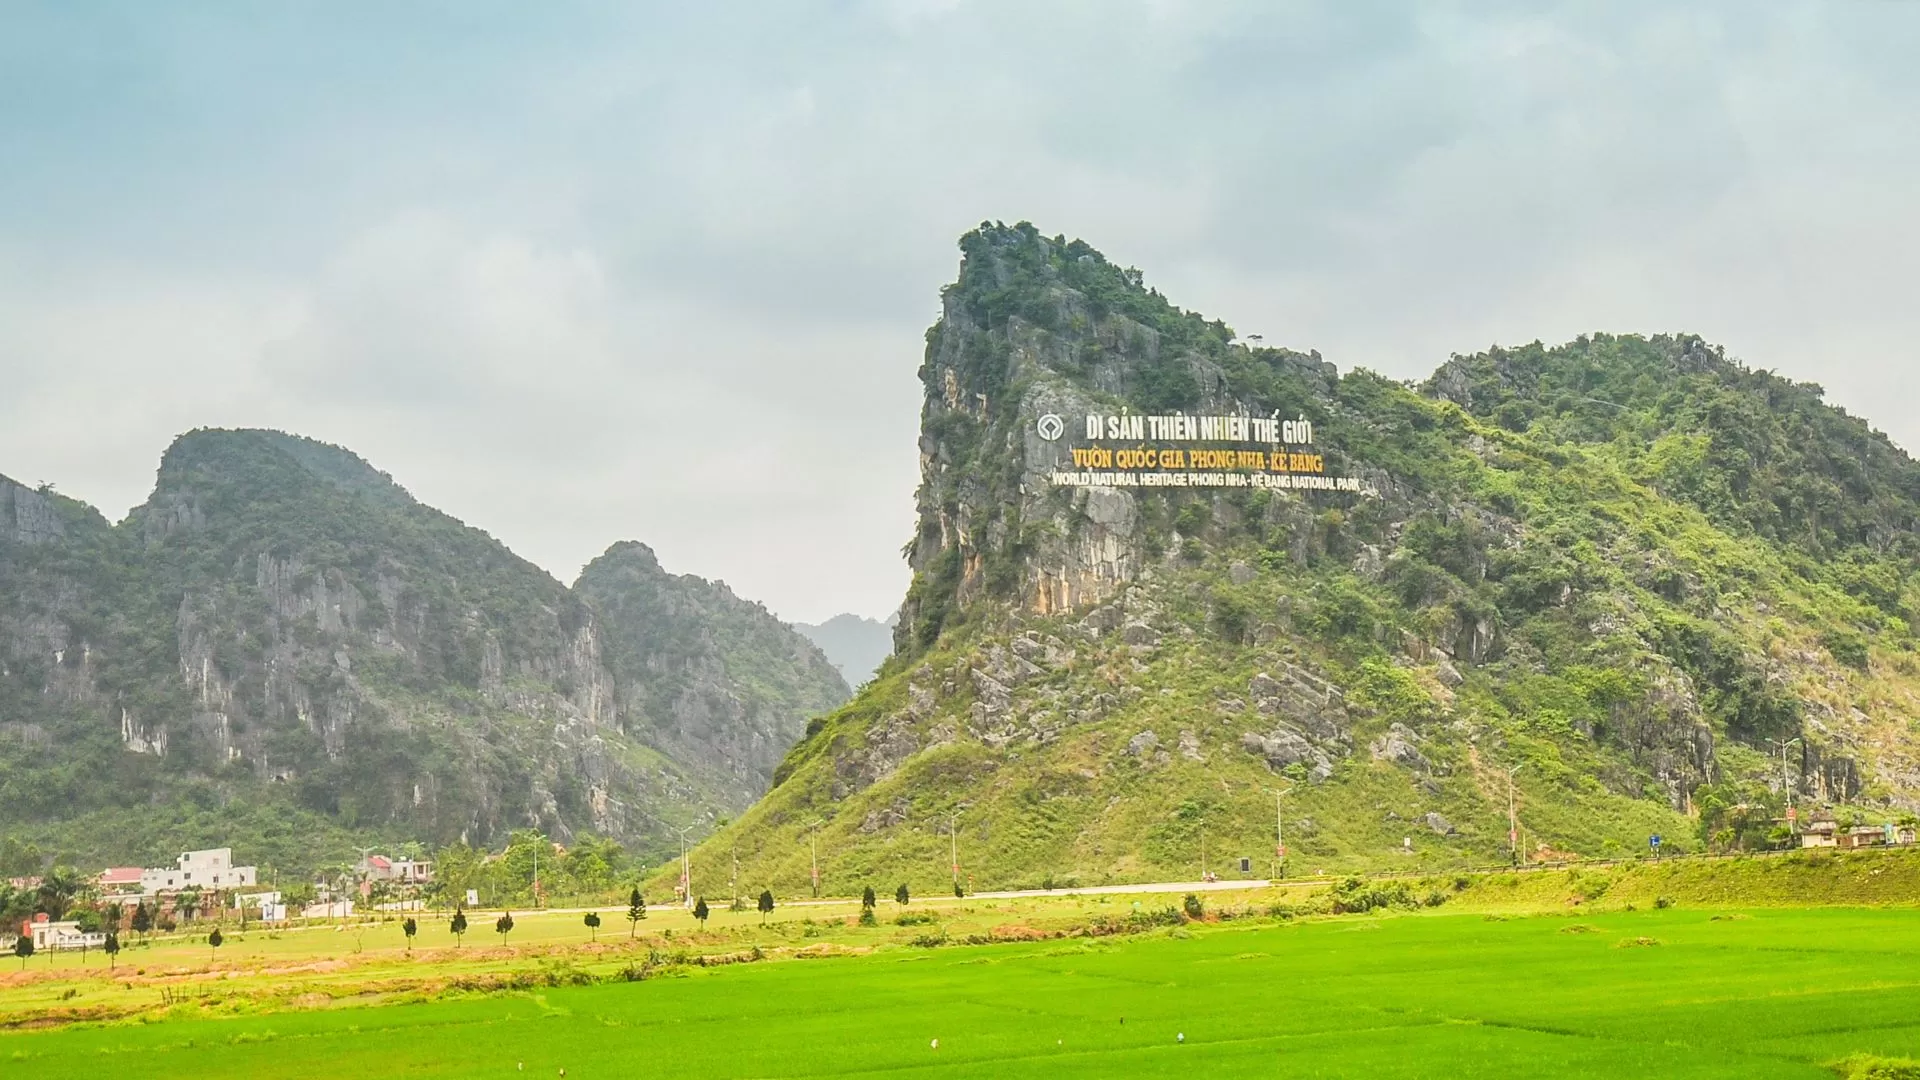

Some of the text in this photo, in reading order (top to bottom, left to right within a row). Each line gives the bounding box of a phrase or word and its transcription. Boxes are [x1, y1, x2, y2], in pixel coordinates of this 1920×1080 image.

[1086, 406, 1312, 444] DI SẢN THIÊN NHIÊN THẾ GIỚI
[1116, 442, 1157, 469] QUỐC
[1159, 450, 1185, 468] GIA
[1189, 450, 1236, 469] PHONG
[1052, 472, 1090, 486] WORLD
[1091, 472, 1140, 486] NATURAL
[1140, 472, 1187, 486] HERITAGE
[1188, 473, 1224, 486] PHONG
[1264, 475, 1291, 488] BANG
[1291, 475, 1337, 490] NATIONAL
[1337, 477, 1360, 491] PARK
